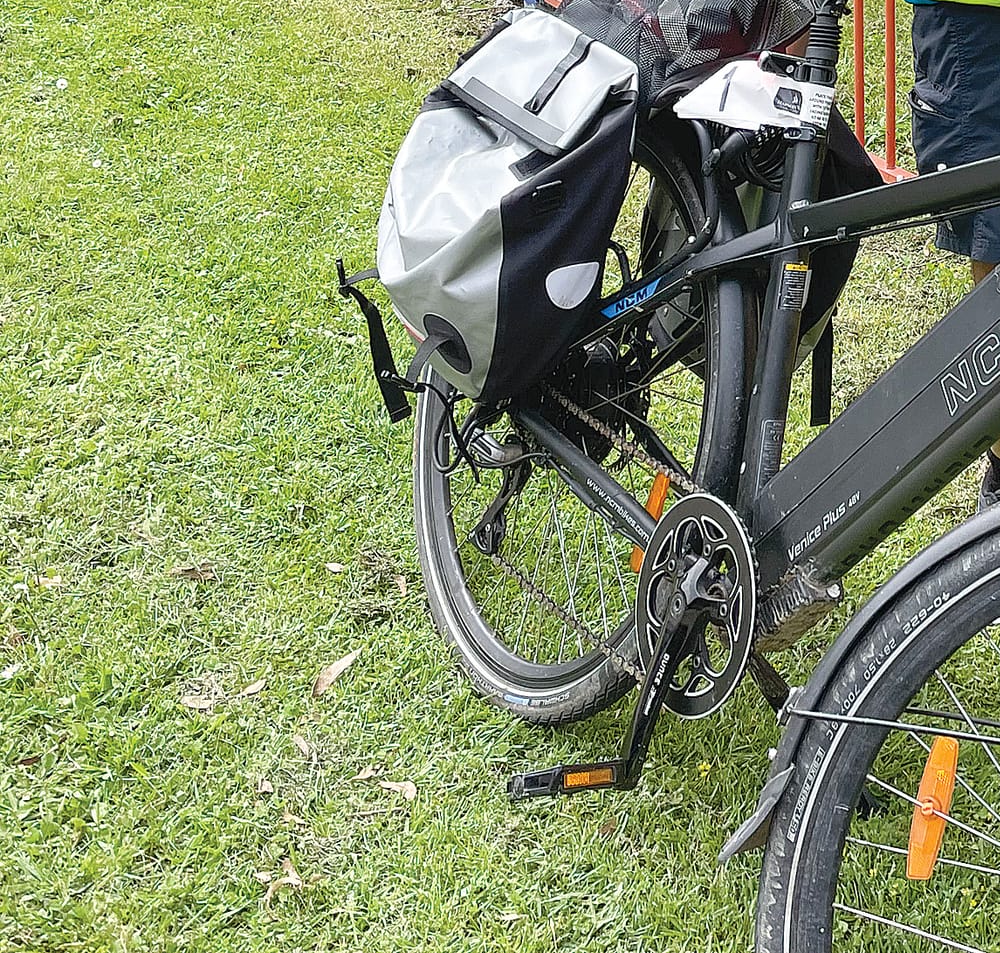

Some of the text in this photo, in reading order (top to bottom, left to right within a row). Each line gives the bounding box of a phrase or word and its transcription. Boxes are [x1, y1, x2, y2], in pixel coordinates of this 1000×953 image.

[614, 287, 650, 314] NCM
[786, 526, 822, 561] Venice
[822, 505, 846, 533] Plus
